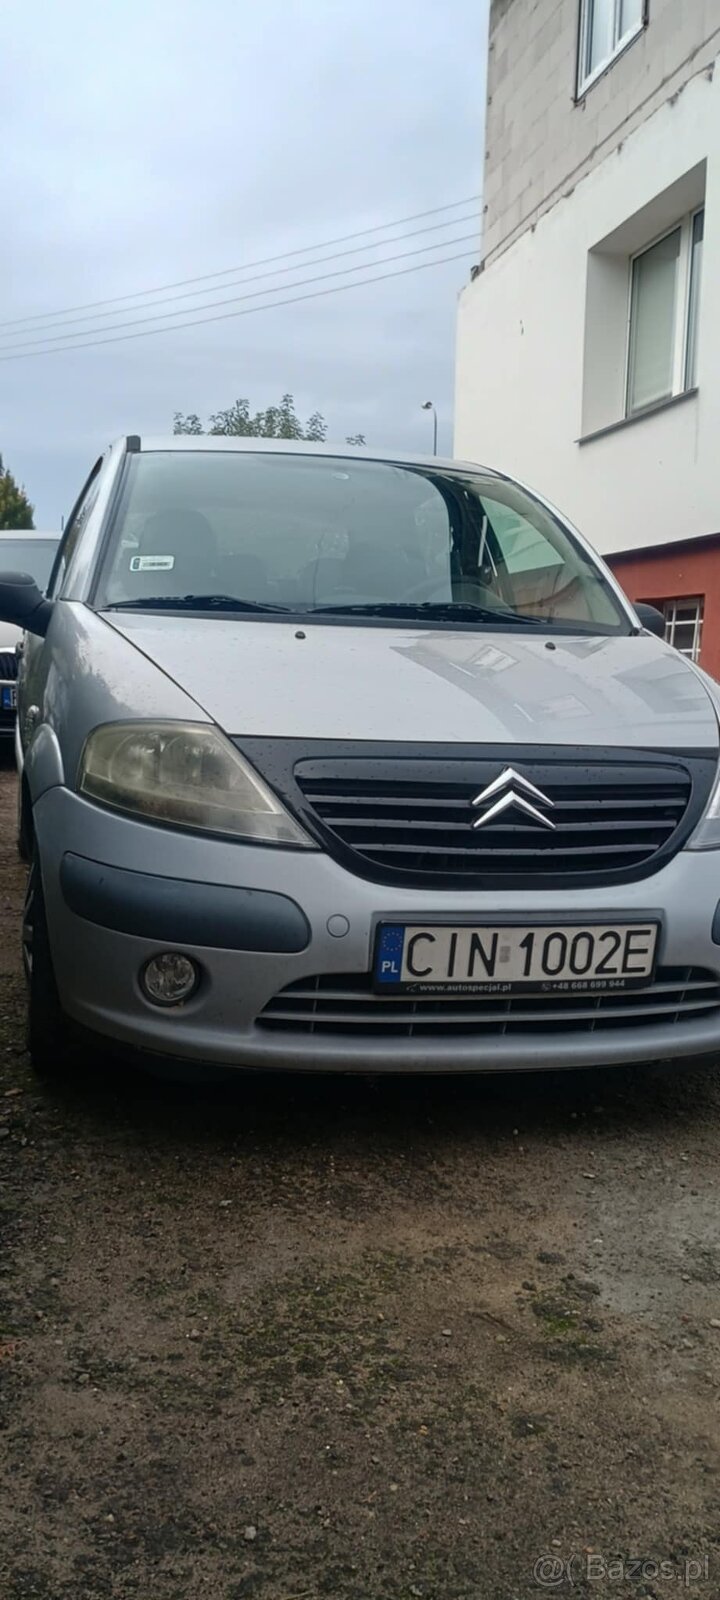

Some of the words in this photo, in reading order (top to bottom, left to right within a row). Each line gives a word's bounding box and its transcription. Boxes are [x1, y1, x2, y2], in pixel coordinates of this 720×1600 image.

[381, 961, 399, 973] PL
[406, 932, 499, 977] CIN
[519, 930, 652, 976] 1002E
